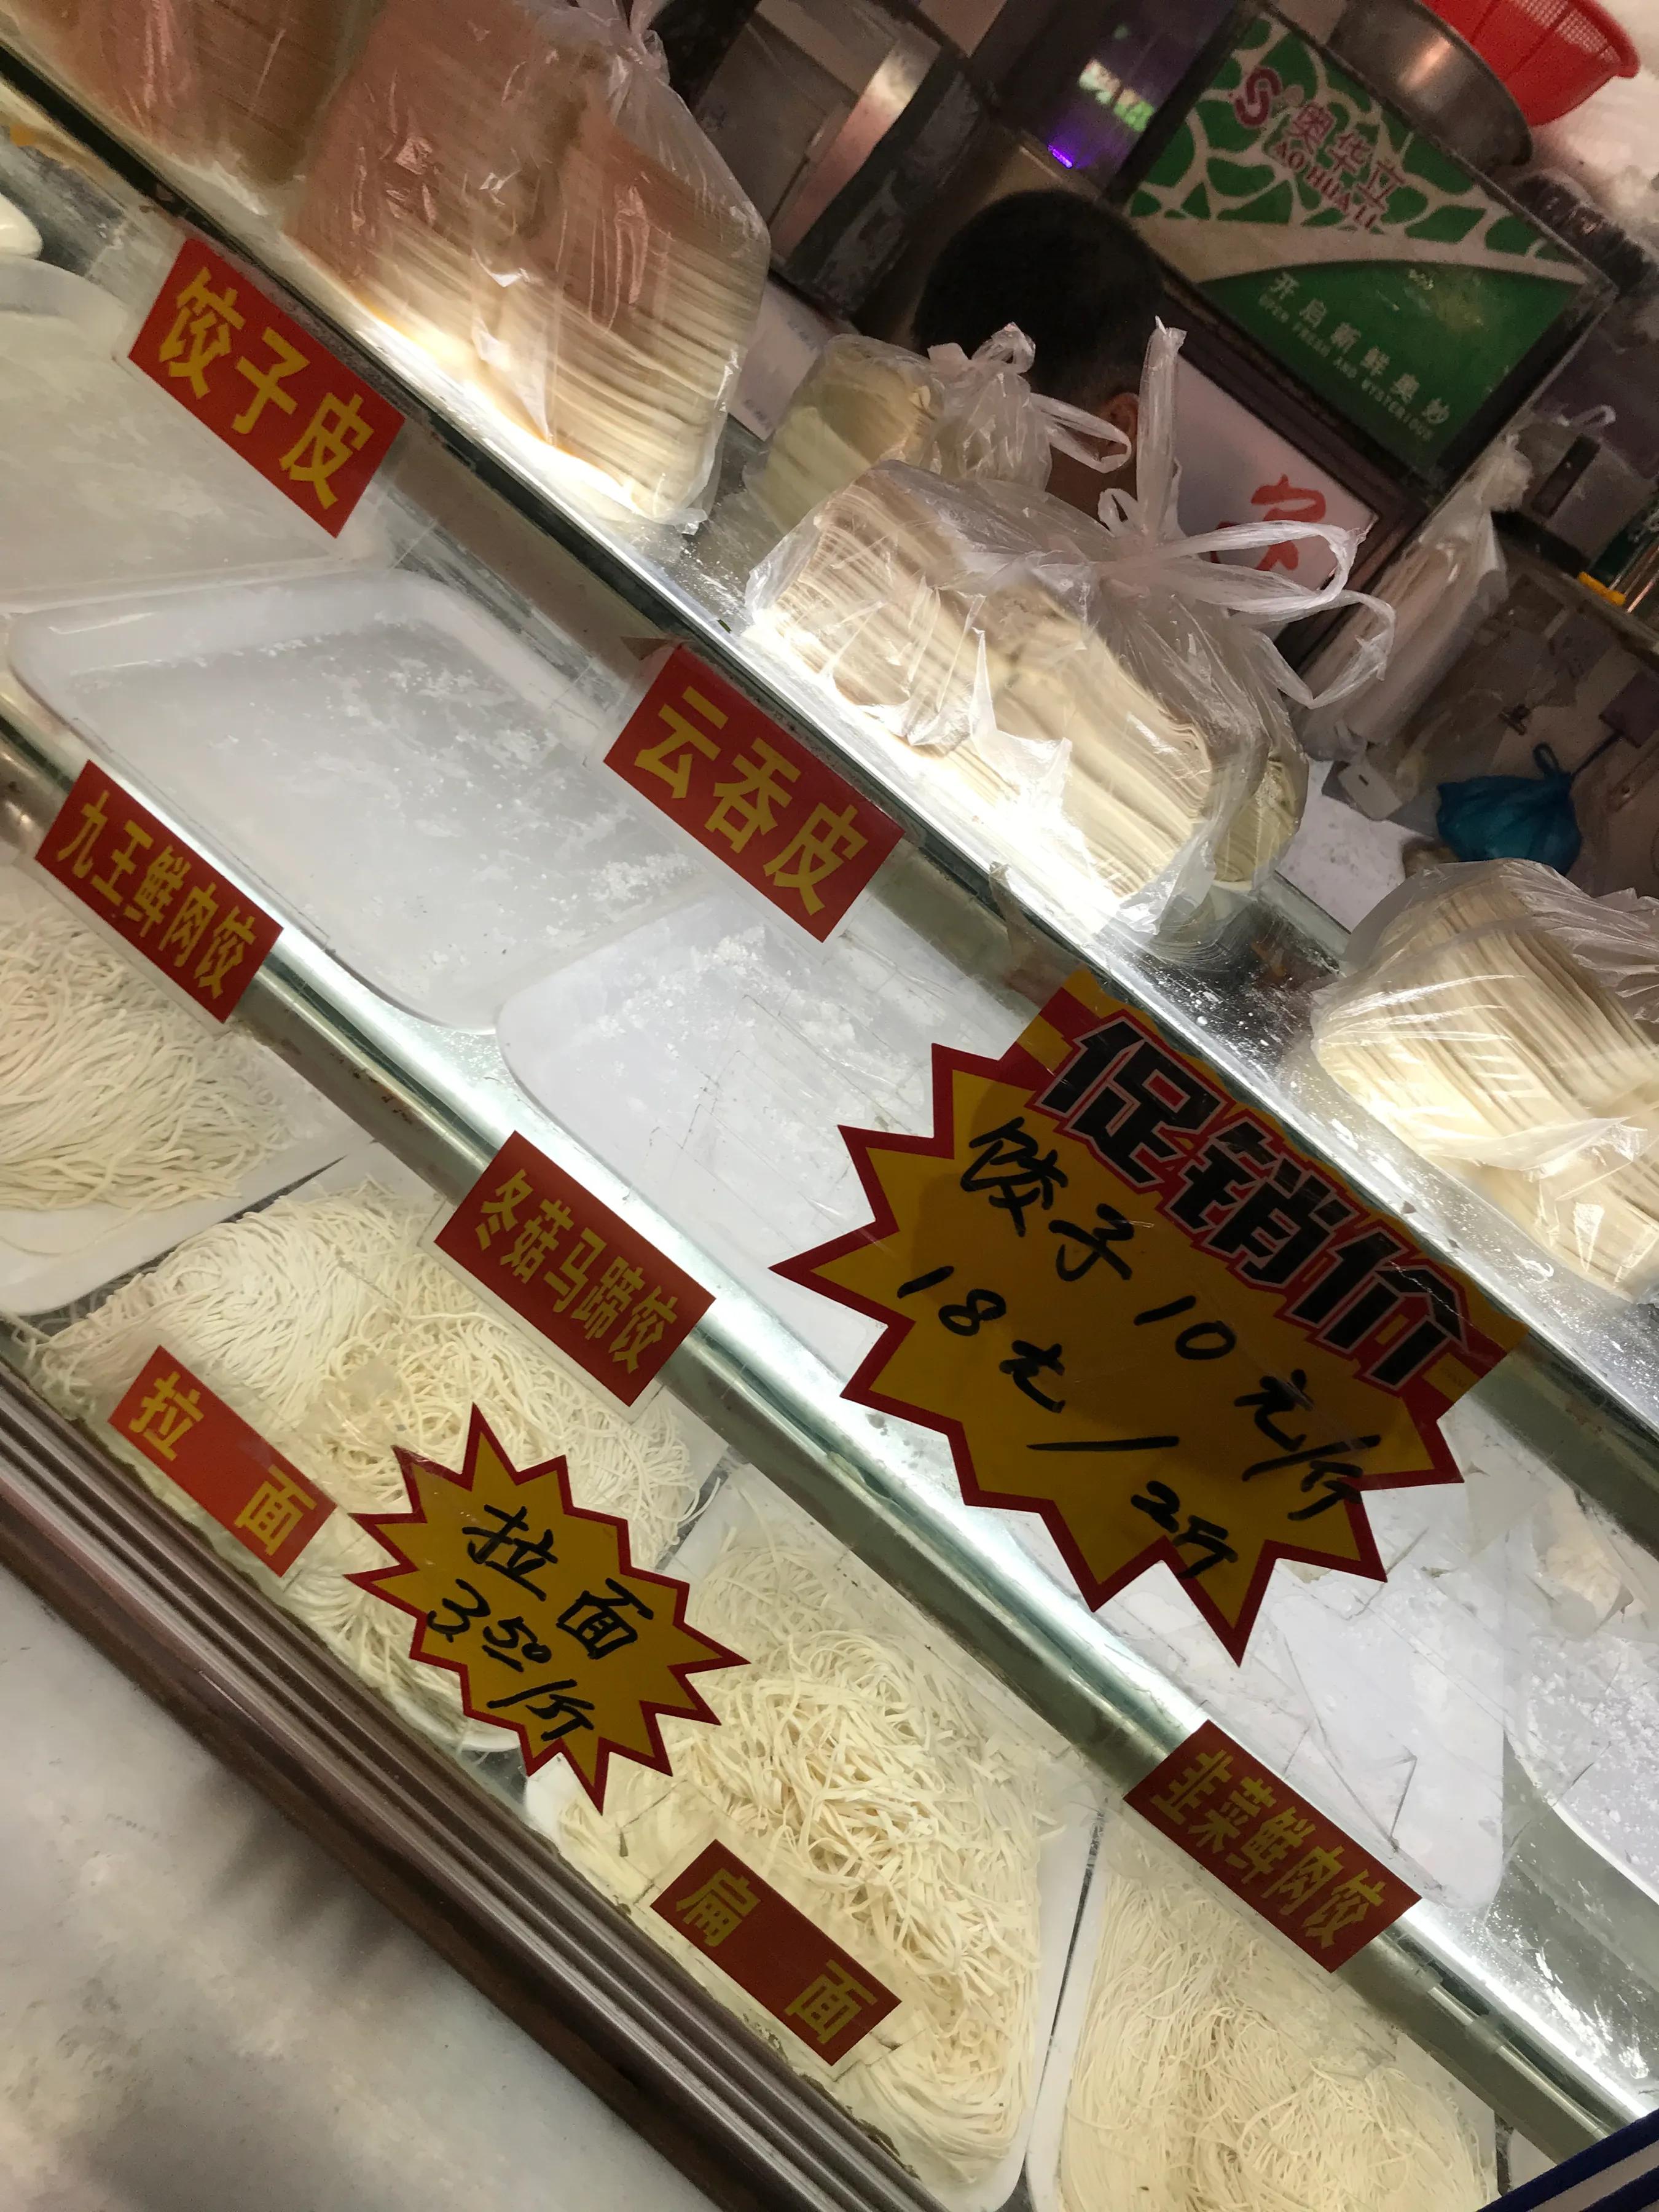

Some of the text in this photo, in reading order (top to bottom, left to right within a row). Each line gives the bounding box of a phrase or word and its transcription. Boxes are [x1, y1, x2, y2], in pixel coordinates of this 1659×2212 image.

[159, 267, 374, 510] 饺子皮
[57, 790, 256, 999] 九王鲜肉饺
[634, 686, 868, 916] 云吞皮
[475, 1169, 677, 1373] 冬菇马蹄饺
[1035, 1015, 1469, 1391] 促销价
[128, 1371, 317, 1556] 拉面
[461, 1504, 654, 1659] 拉面
[1150, 1749, 1386, 1948] 韭菜鲜肉饺
[676, 1868, 877, 2044] 扁面
